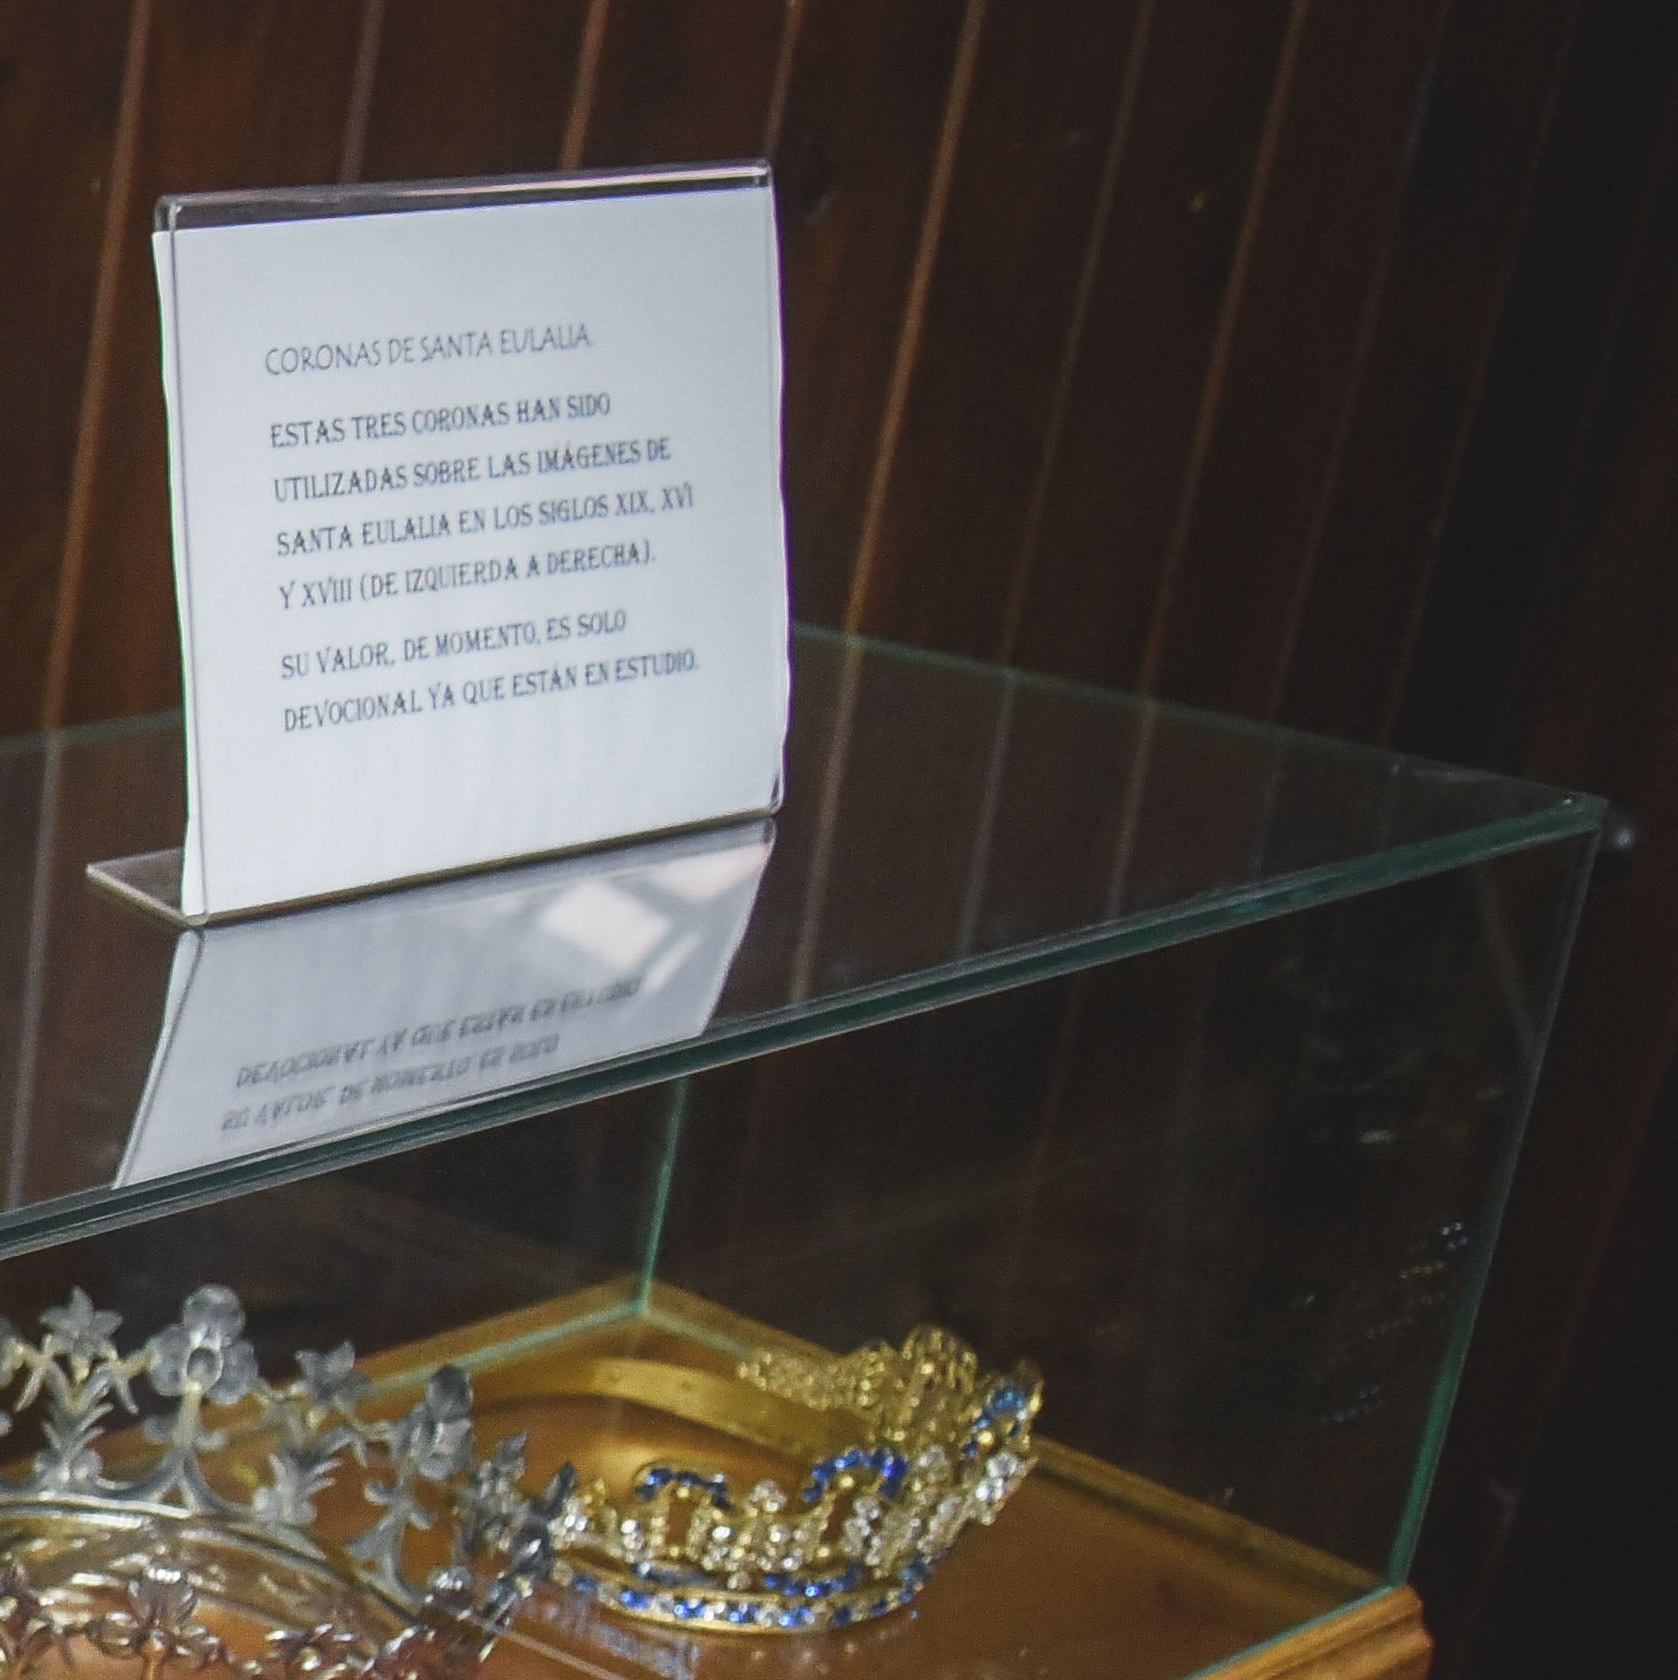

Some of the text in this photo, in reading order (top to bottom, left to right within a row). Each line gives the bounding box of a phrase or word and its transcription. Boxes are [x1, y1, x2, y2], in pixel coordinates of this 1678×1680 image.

[264, 339, 382, 377] CORONAS
[388, 336, 415, 365] DE
[420, 331, 494, 363] SANTA
[270, 393, 611, 449] ESTAS TRES CORONAS HAN SIDO
[274, 436, 671, 503] UTILIZADAS SOBRE LAS IMÁGENES DE
[276, 524, 354, 557] SANTA
[362, 513, 451, 547] EULALIA
[458, 509, 486, 534] EN
[493, 502, 533, 531] LOS
[538, 494, 609, 525] SIGLOS
[662, 482, 693, 511] XVI
[279, 580, 295, 610] Y
[302, 576, 352, 608] XVIII
[359, 571, 399, 601] (DE
[405, 557, 519, 594] IZQUIERDA
[526, 554, 541, 579] A
[281, 653, 309, 680] SU
[403, 635, 430, 662] DE
[547, 615, 571, 642] ES
[284, 689, 423, 732] DEVOCIONAL
[428, 682, 455, 710] YA
[462, 676, 505, 706] QUE
[584, 662, 609, 687] EN
